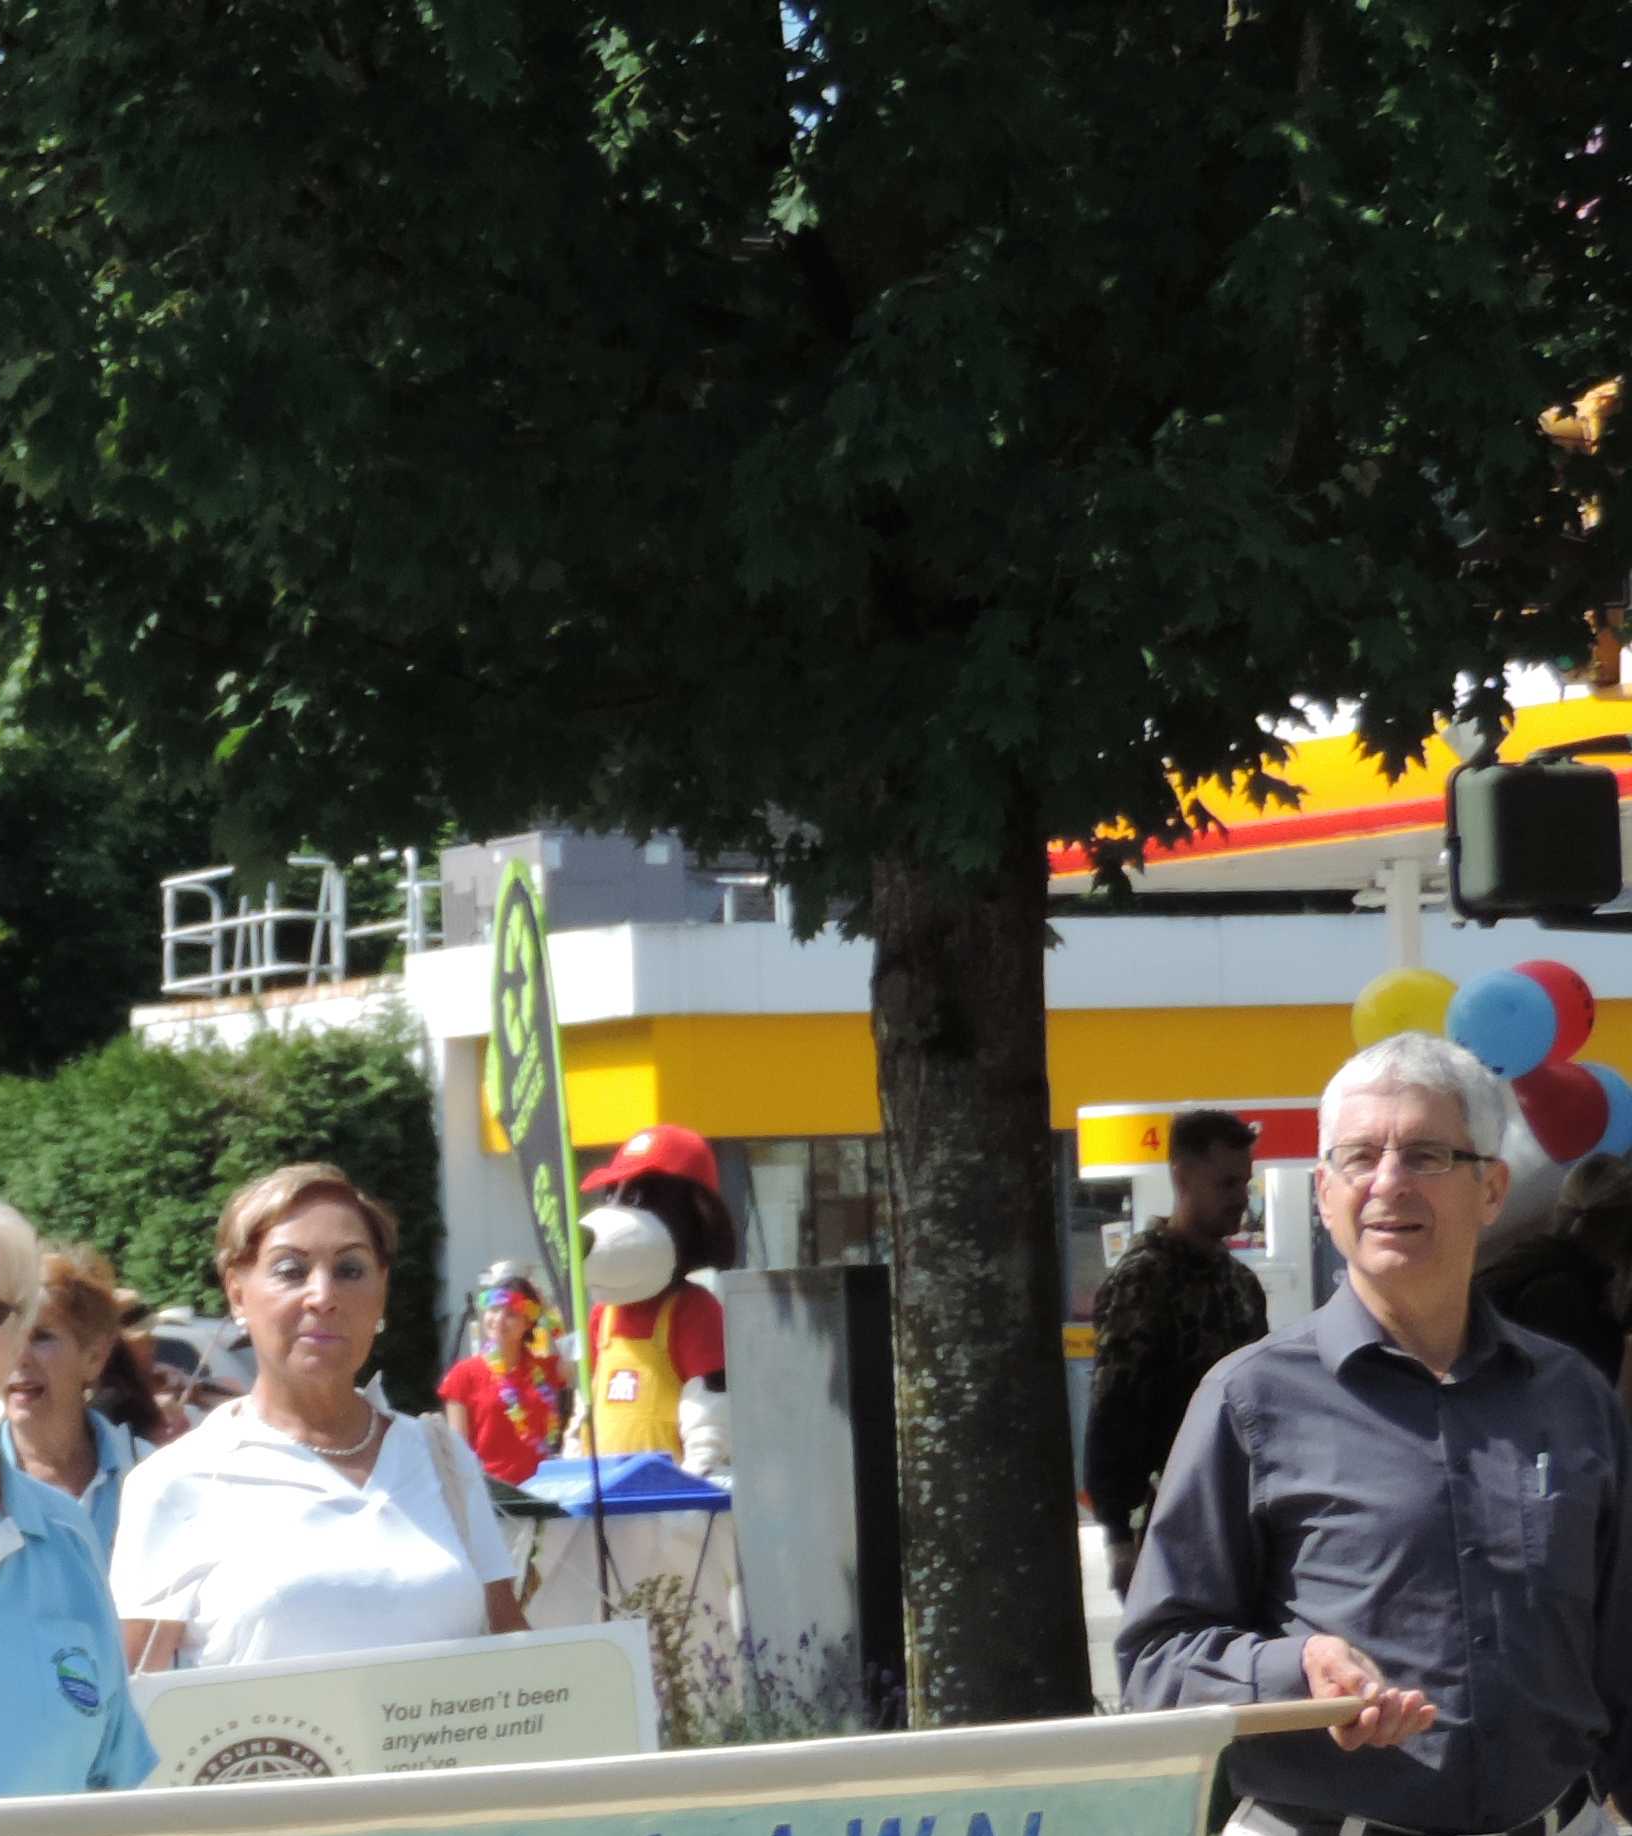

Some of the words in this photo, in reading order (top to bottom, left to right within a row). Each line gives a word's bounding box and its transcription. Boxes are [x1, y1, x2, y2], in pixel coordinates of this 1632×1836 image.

[1140, 1127, 1160, 1151] 4
[381, 1702, 423, 1722] You
[429, 1690, 510, 1718] haven't
[517, 1687, 570, 1707] been
[175, 1719, 239, 1773] WORLD
[382, 1724, 488, 1753] anywhere
[495, 1714, 545, 1739] until
[289, 1745, 326, 1776] THE
